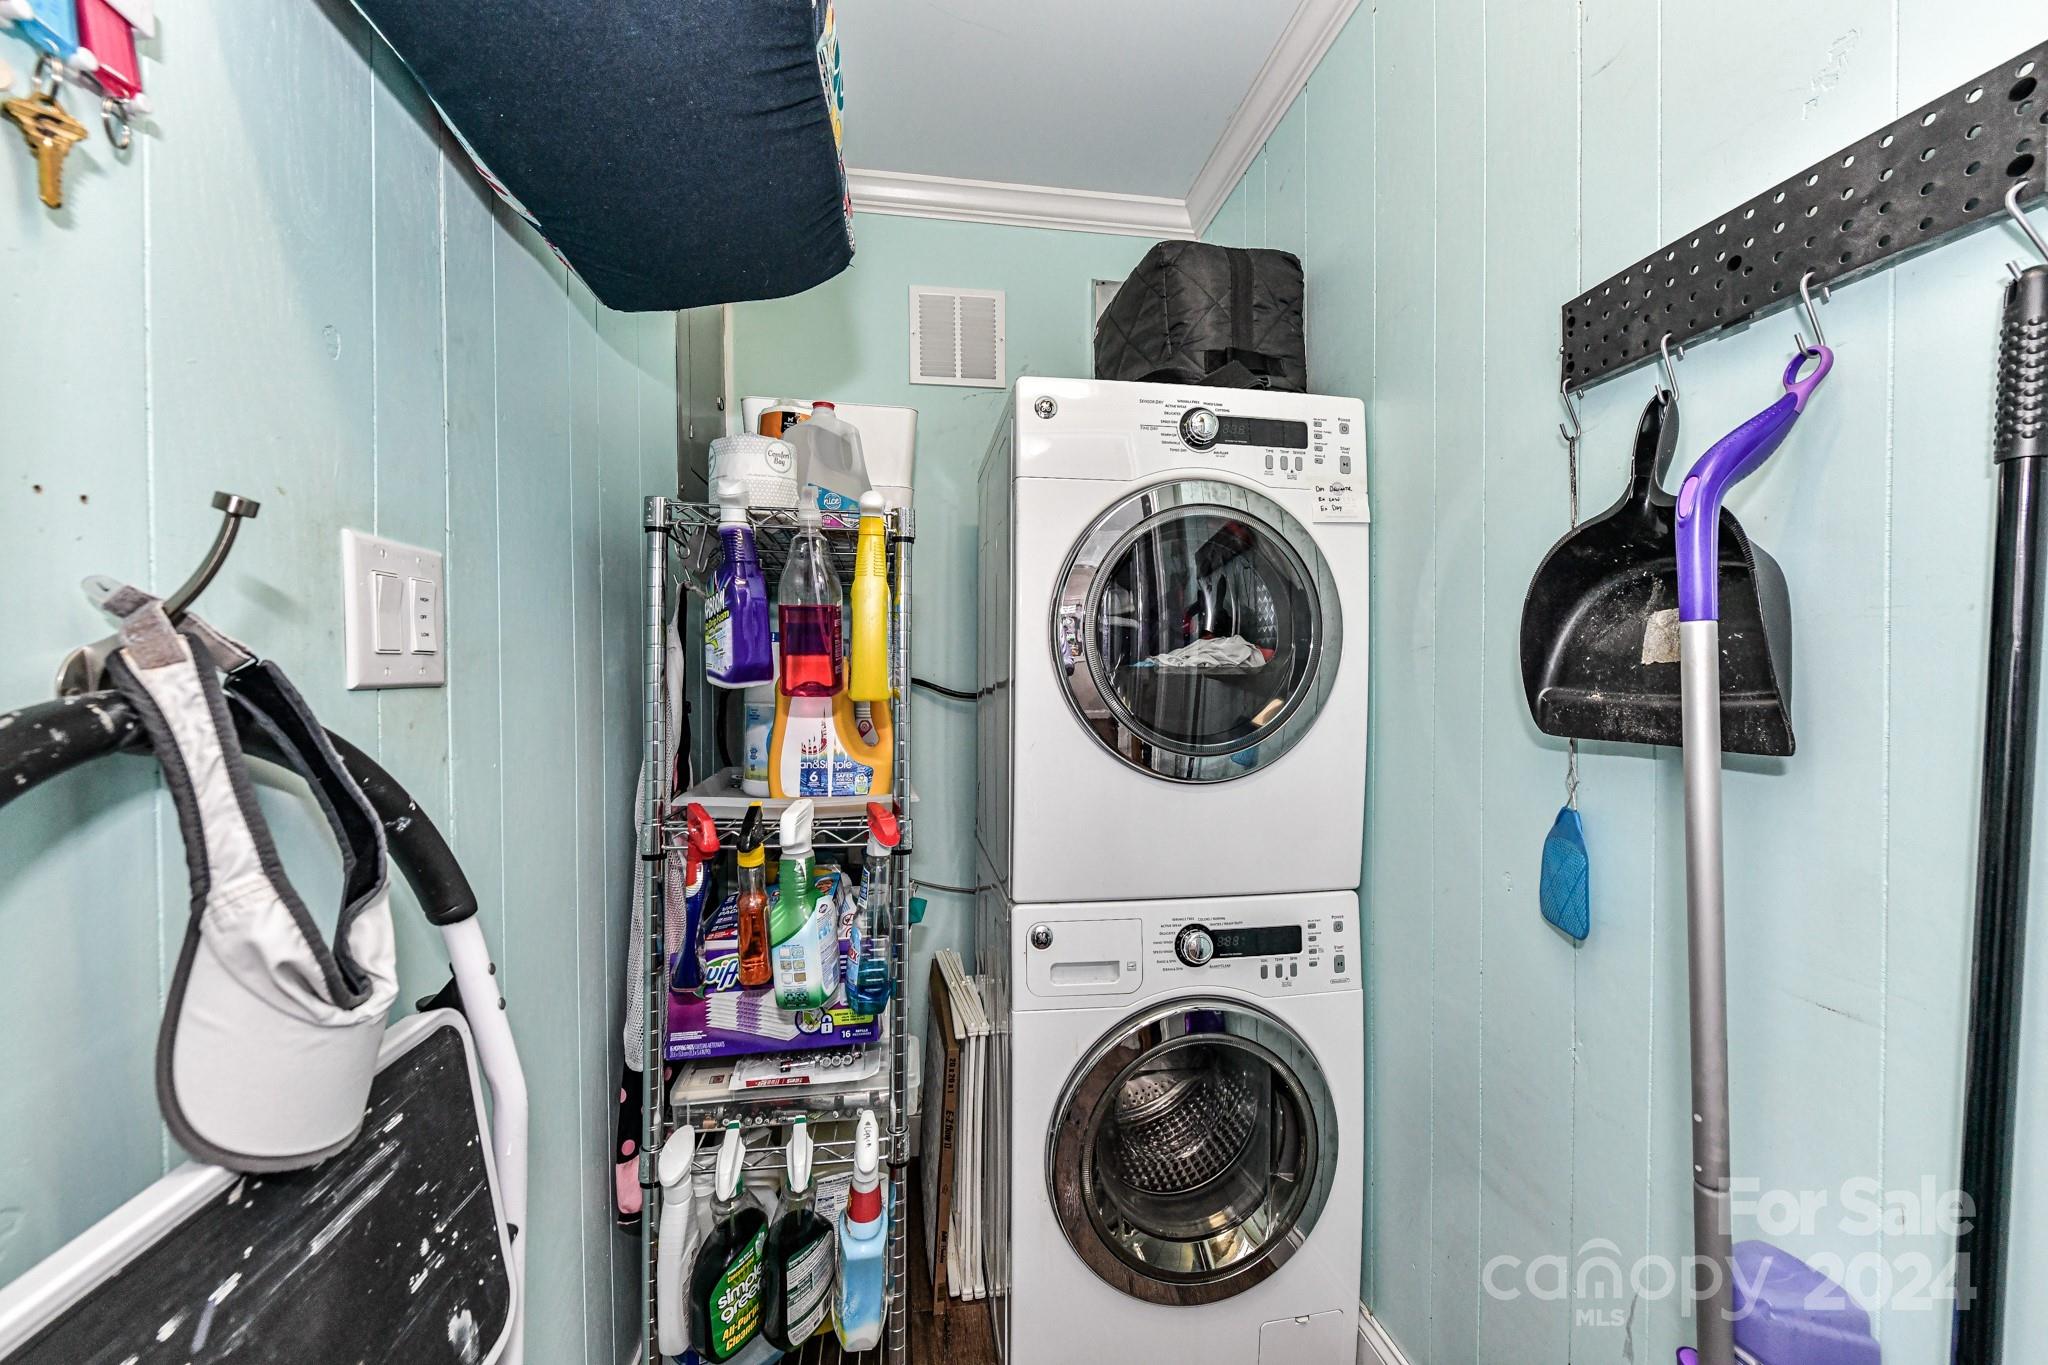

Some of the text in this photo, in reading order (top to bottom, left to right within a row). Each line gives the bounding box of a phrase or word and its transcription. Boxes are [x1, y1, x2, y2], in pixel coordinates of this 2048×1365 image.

[773, 456, 786, 467] Bay
[809, 771, 818, 782] 6
[841, 1030, 851, 1039] 16
[949, 1058, 956, 1067] 20
[948, 1073, 956, 1083] 20
